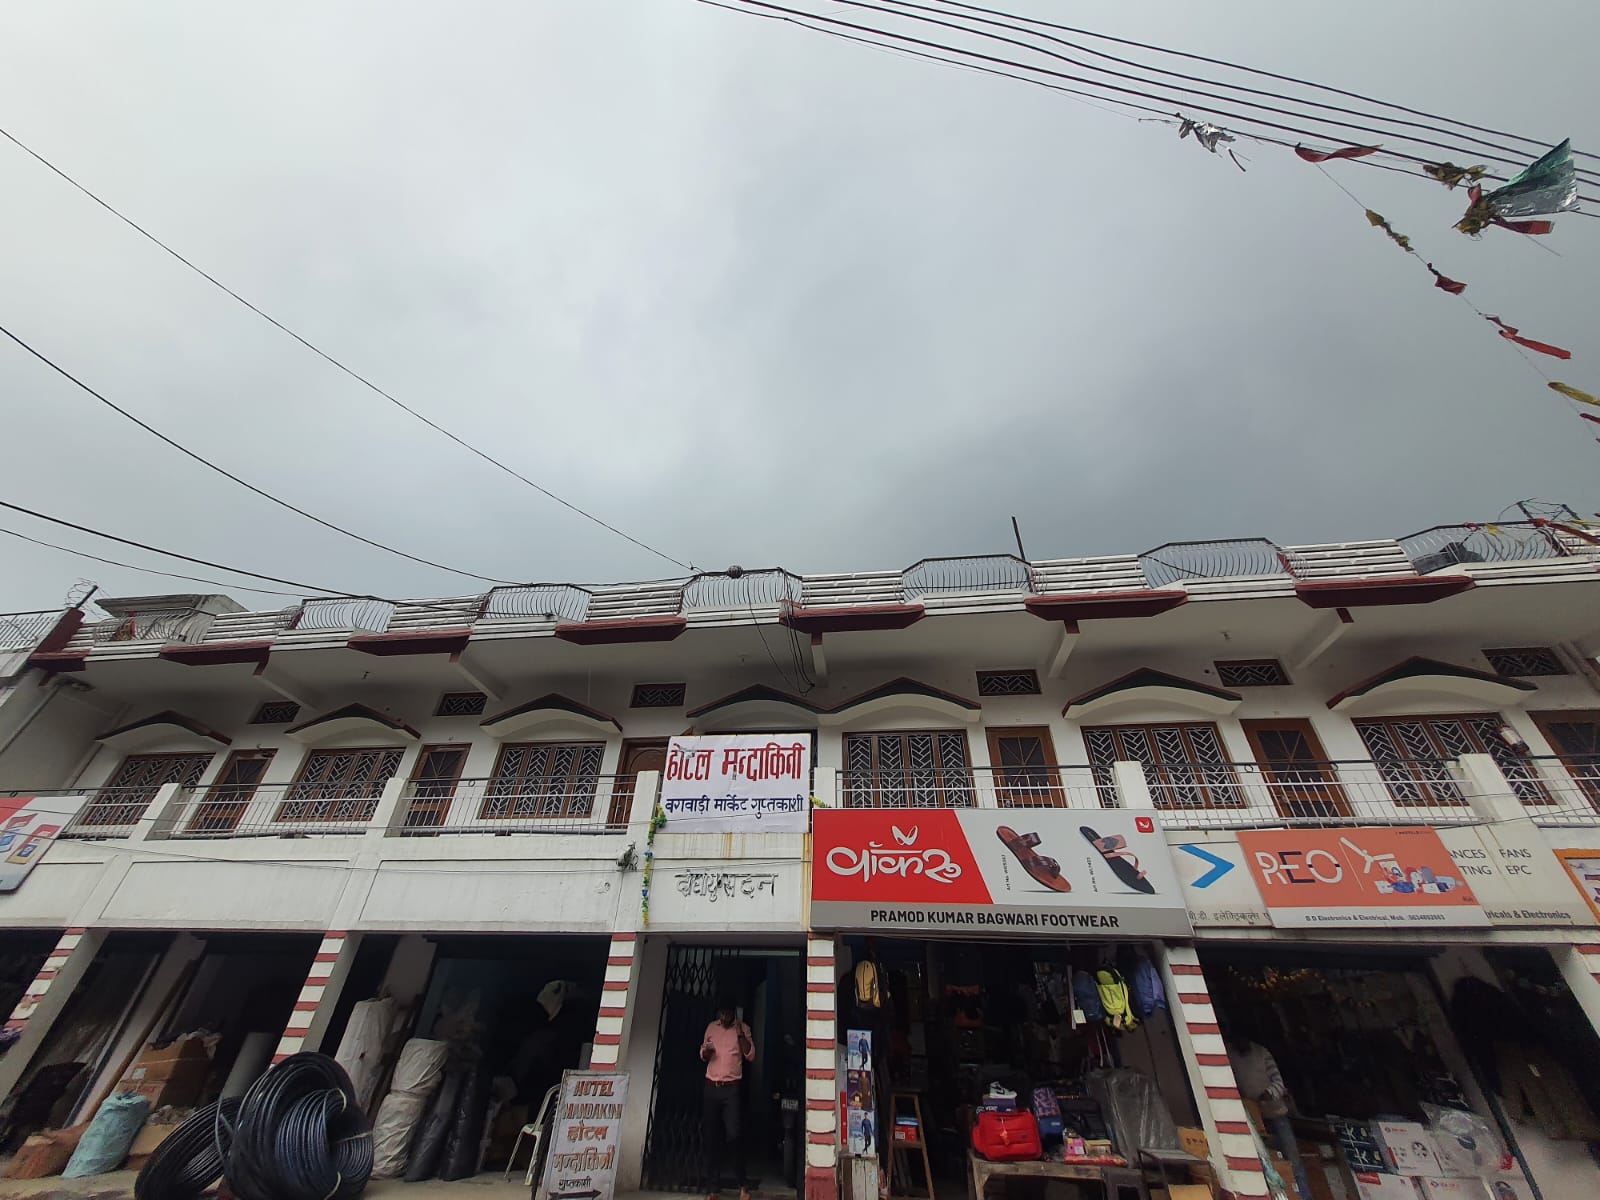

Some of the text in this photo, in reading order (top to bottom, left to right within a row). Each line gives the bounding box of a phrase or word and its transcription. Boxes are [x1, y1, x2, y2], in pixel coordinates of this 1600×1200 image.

[667, 743, 715, 780] होटल
[751, 794, 803, 819] गुप्तकाशी
[1499, 848, 1532, 858] FANS
[1255, 849, 1343, 885] REO
[1505, 865, 1532, 875] EPC
[870, 909, 1120, 928] PRAMOD KUMAR BAGWARI FOOTWEAR
[1513, 911, 1521, 919] &
[1521, 909, 1571, 919] Electronics
[573, 1081, 614, 1096] HOTEL
